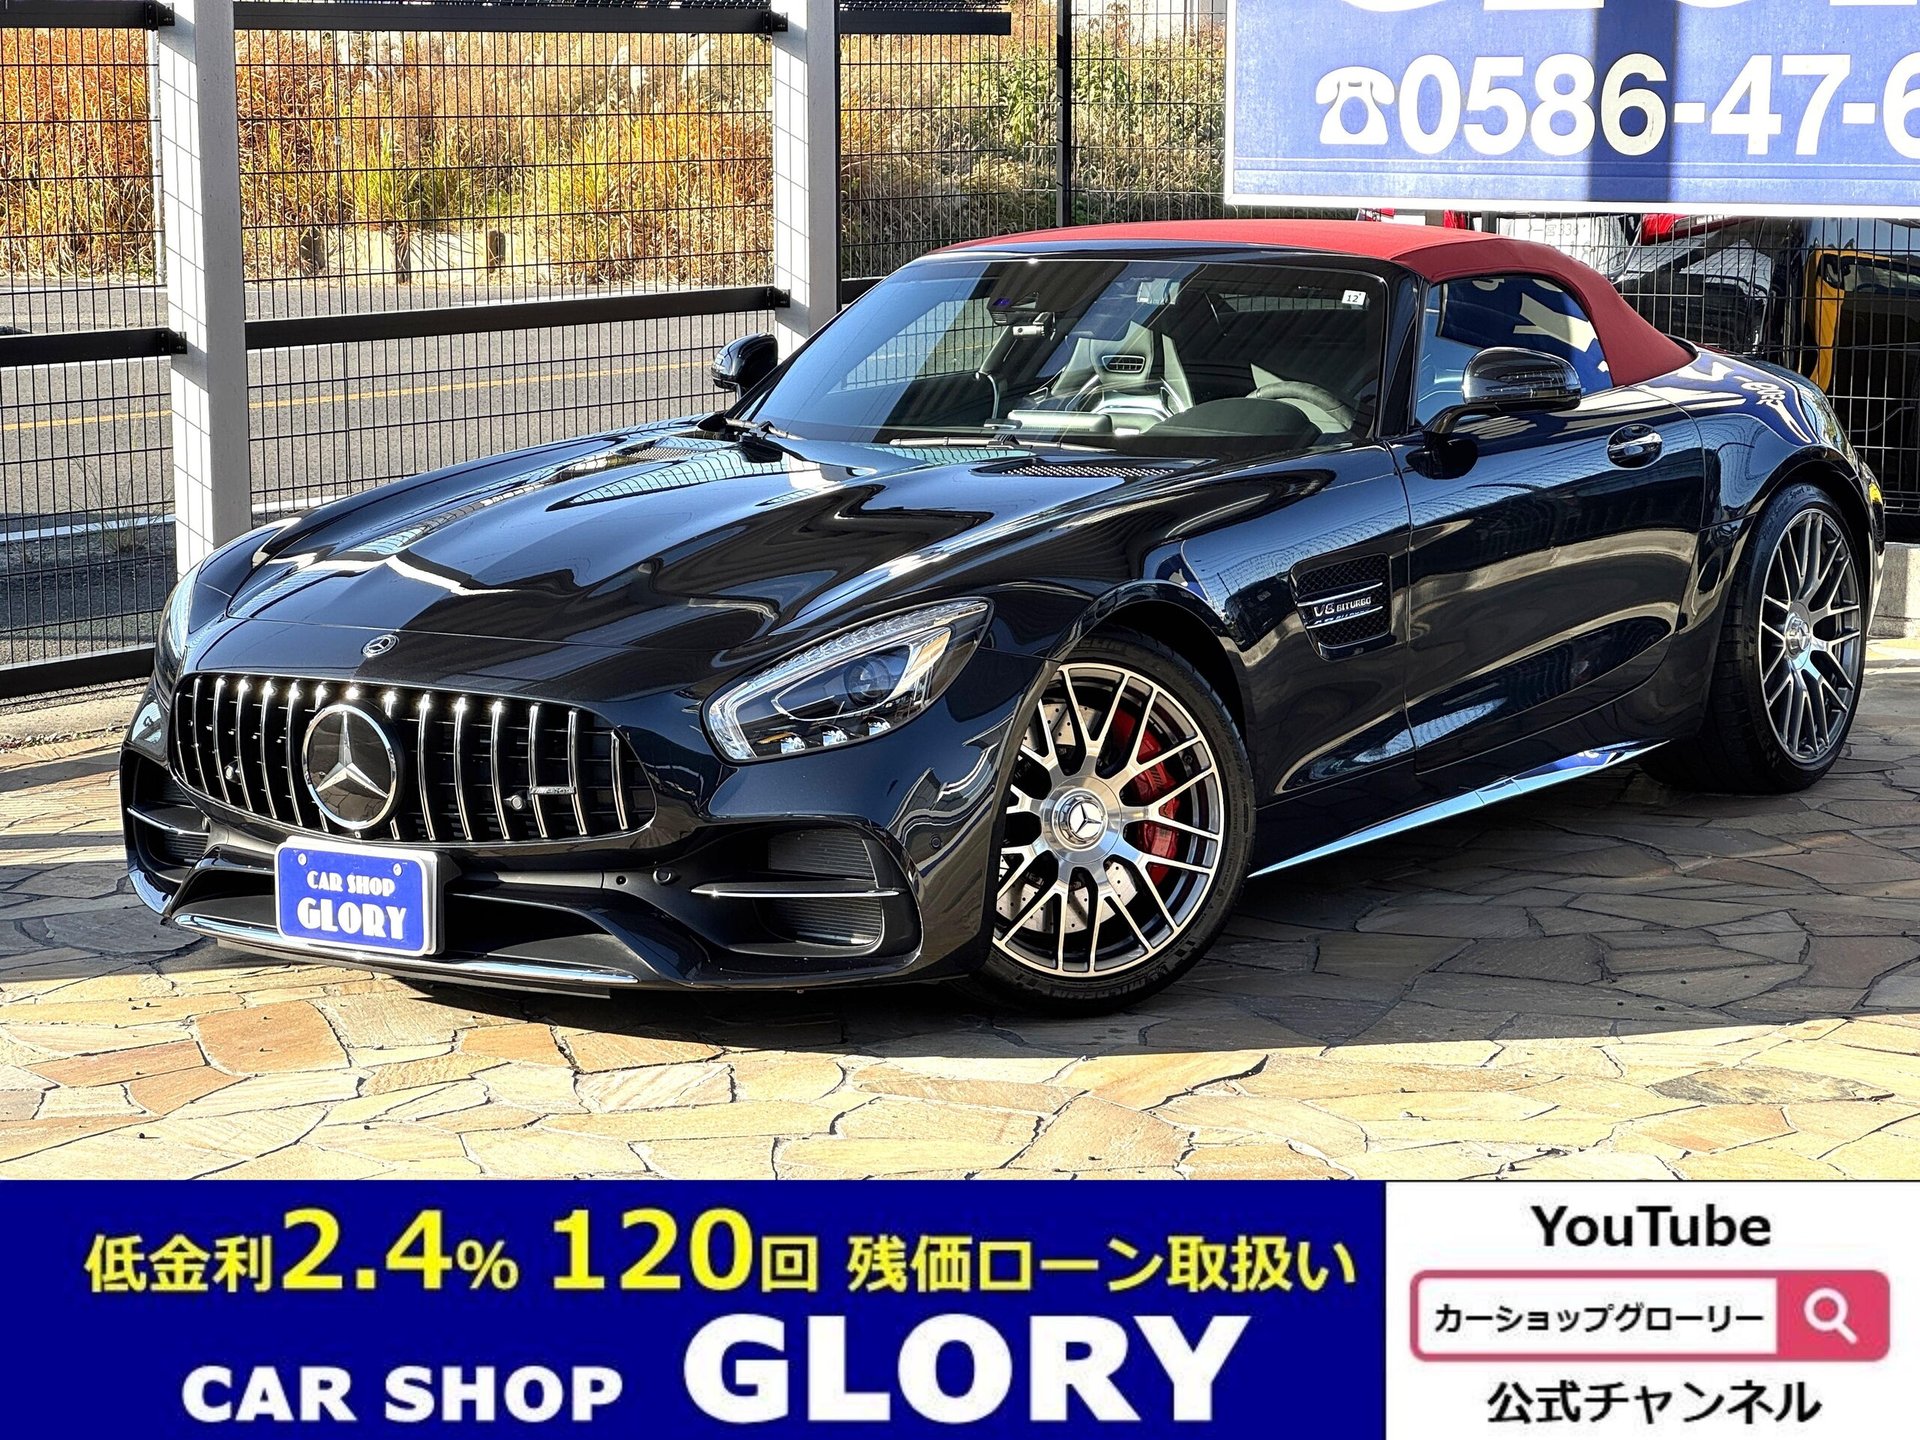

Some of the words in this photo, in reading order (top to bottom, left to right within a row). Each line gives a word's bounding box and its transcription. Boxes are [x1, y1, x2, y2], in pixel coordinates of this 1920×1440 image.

[306, 870, 343, 892] CAR
[346, 874, 396, 897] SHOP
[297, 896, 407, 940] GLORY
